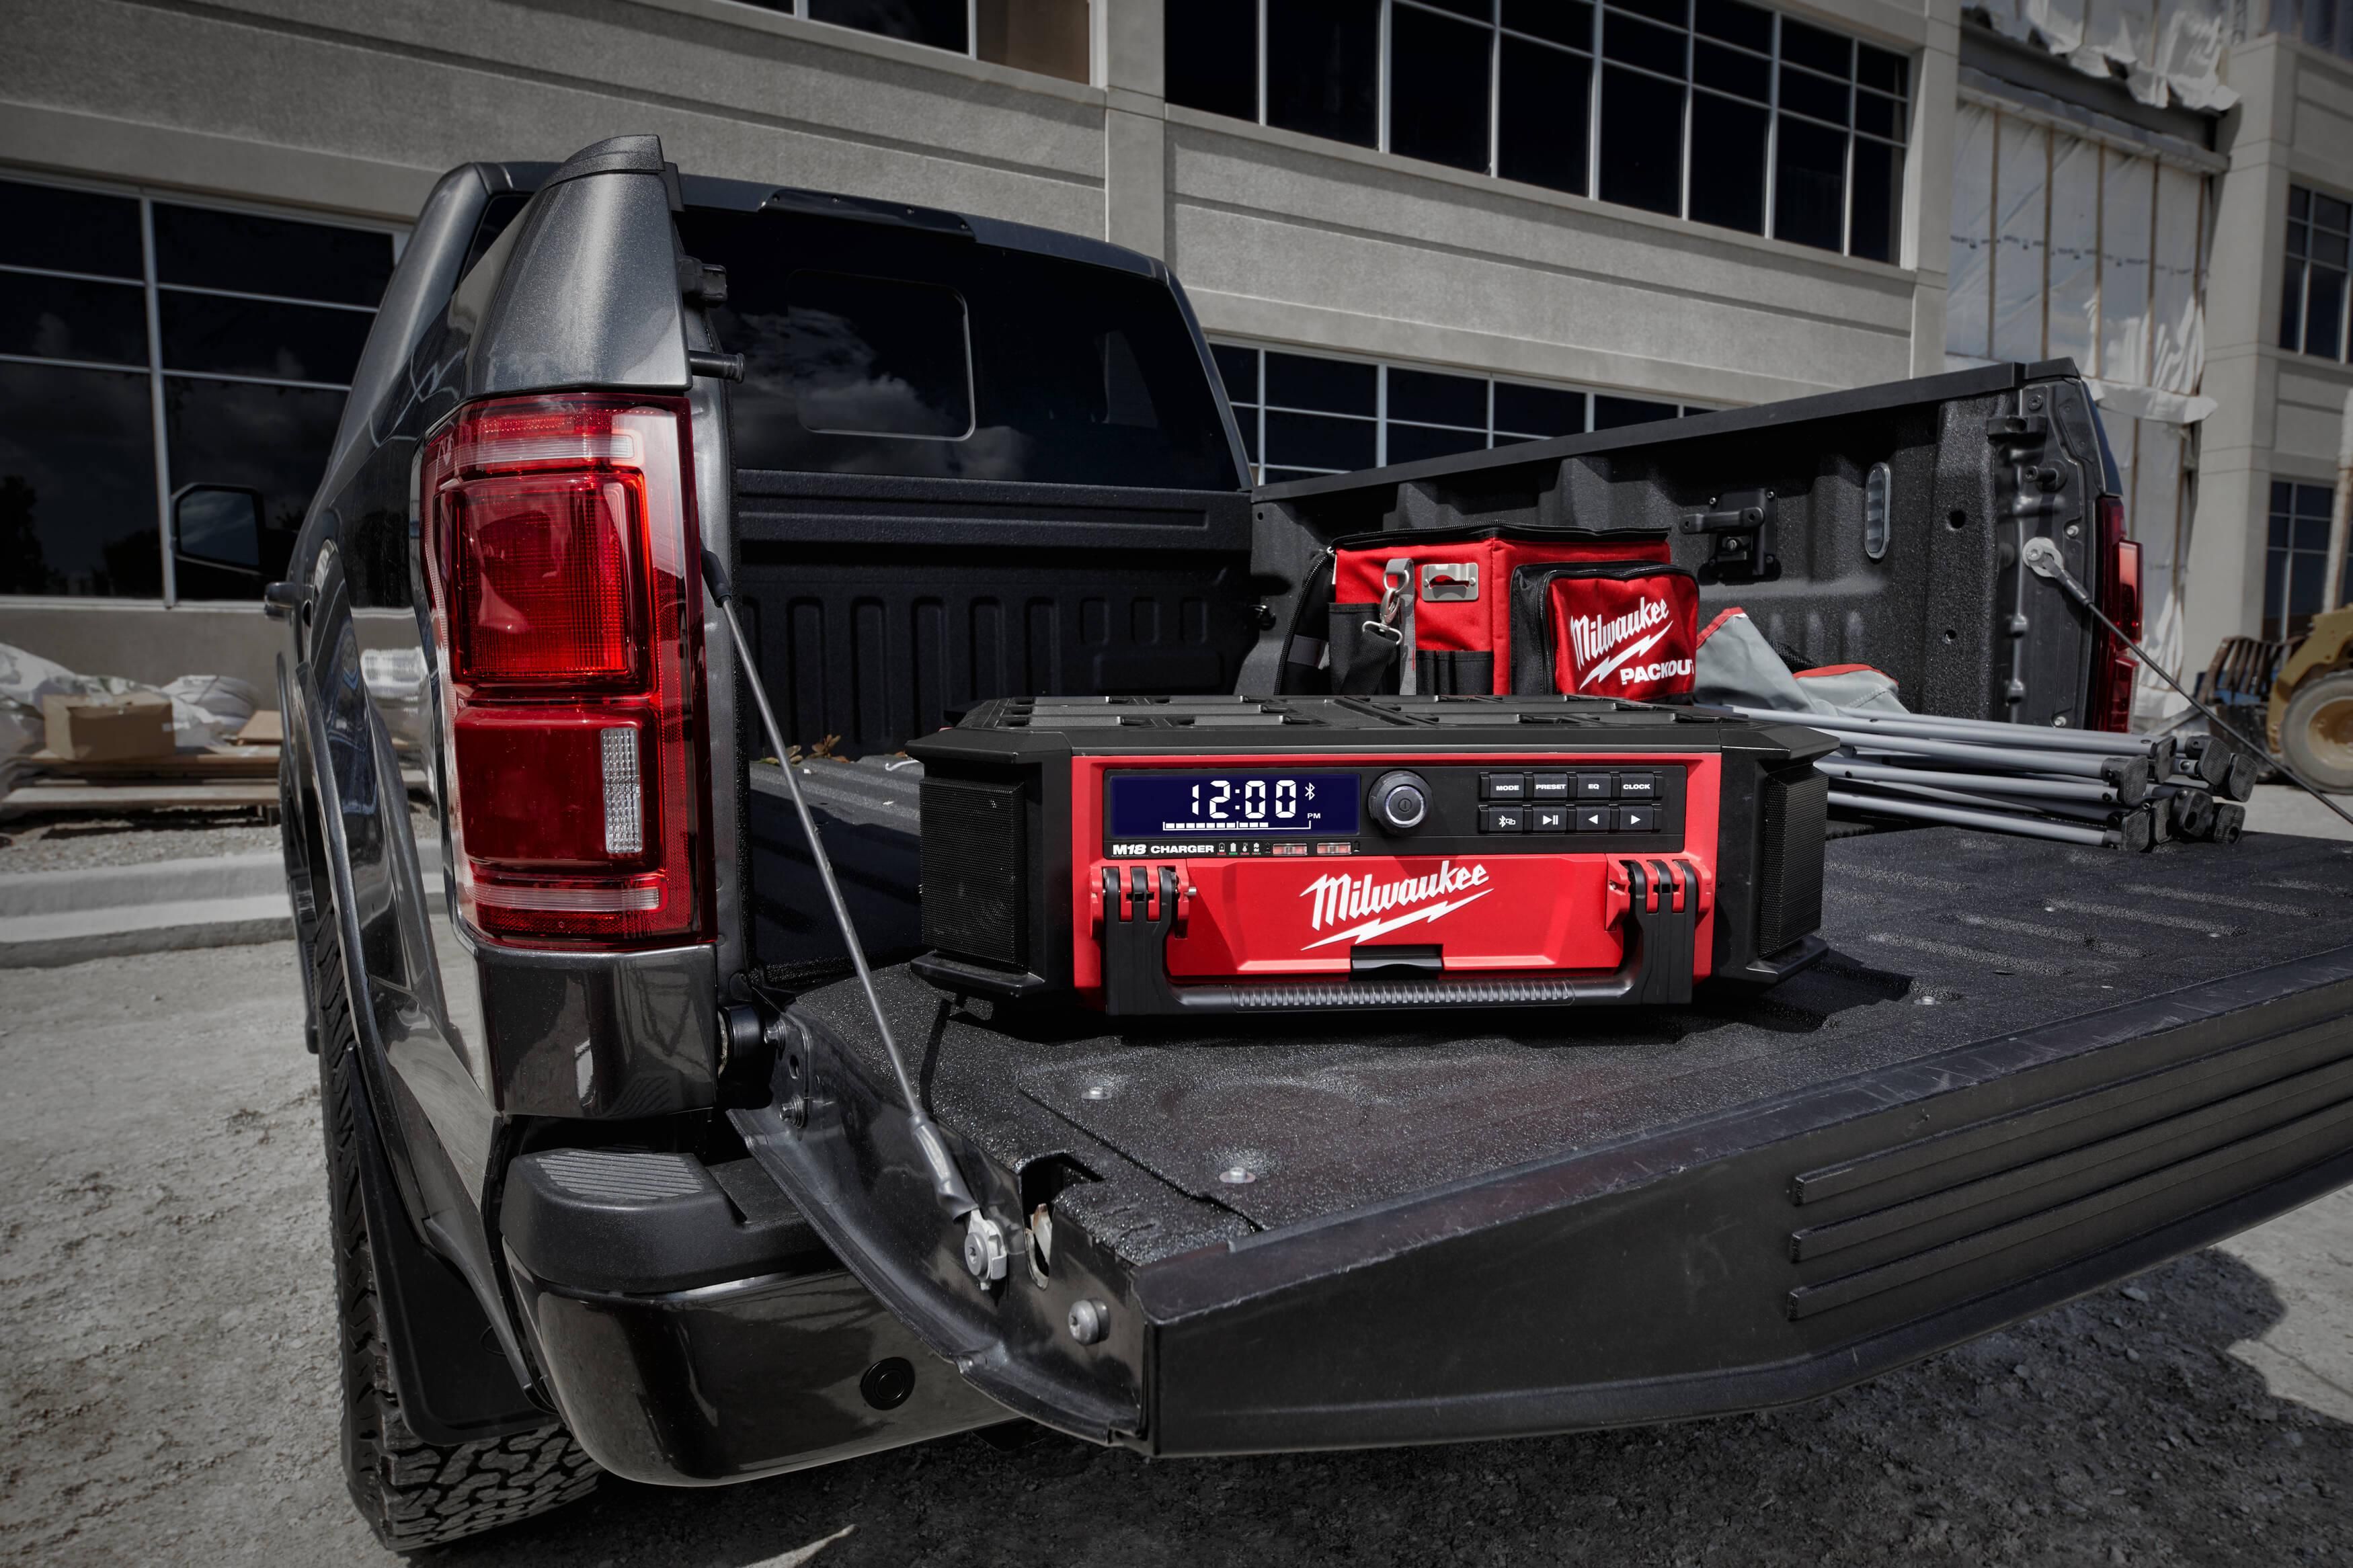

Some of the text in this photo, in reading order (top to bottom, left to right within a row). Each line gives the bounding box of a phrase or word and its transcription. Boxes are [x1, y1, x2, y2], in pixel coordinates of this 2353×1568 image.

[1570, 597, 1669, 671] Milwaukee
[1192, 780, 1296, 819] 12:00
[1113, 843, 1214, 856] M18 CHARGER
[1300, 860, 1490, 931] Milwaukee
